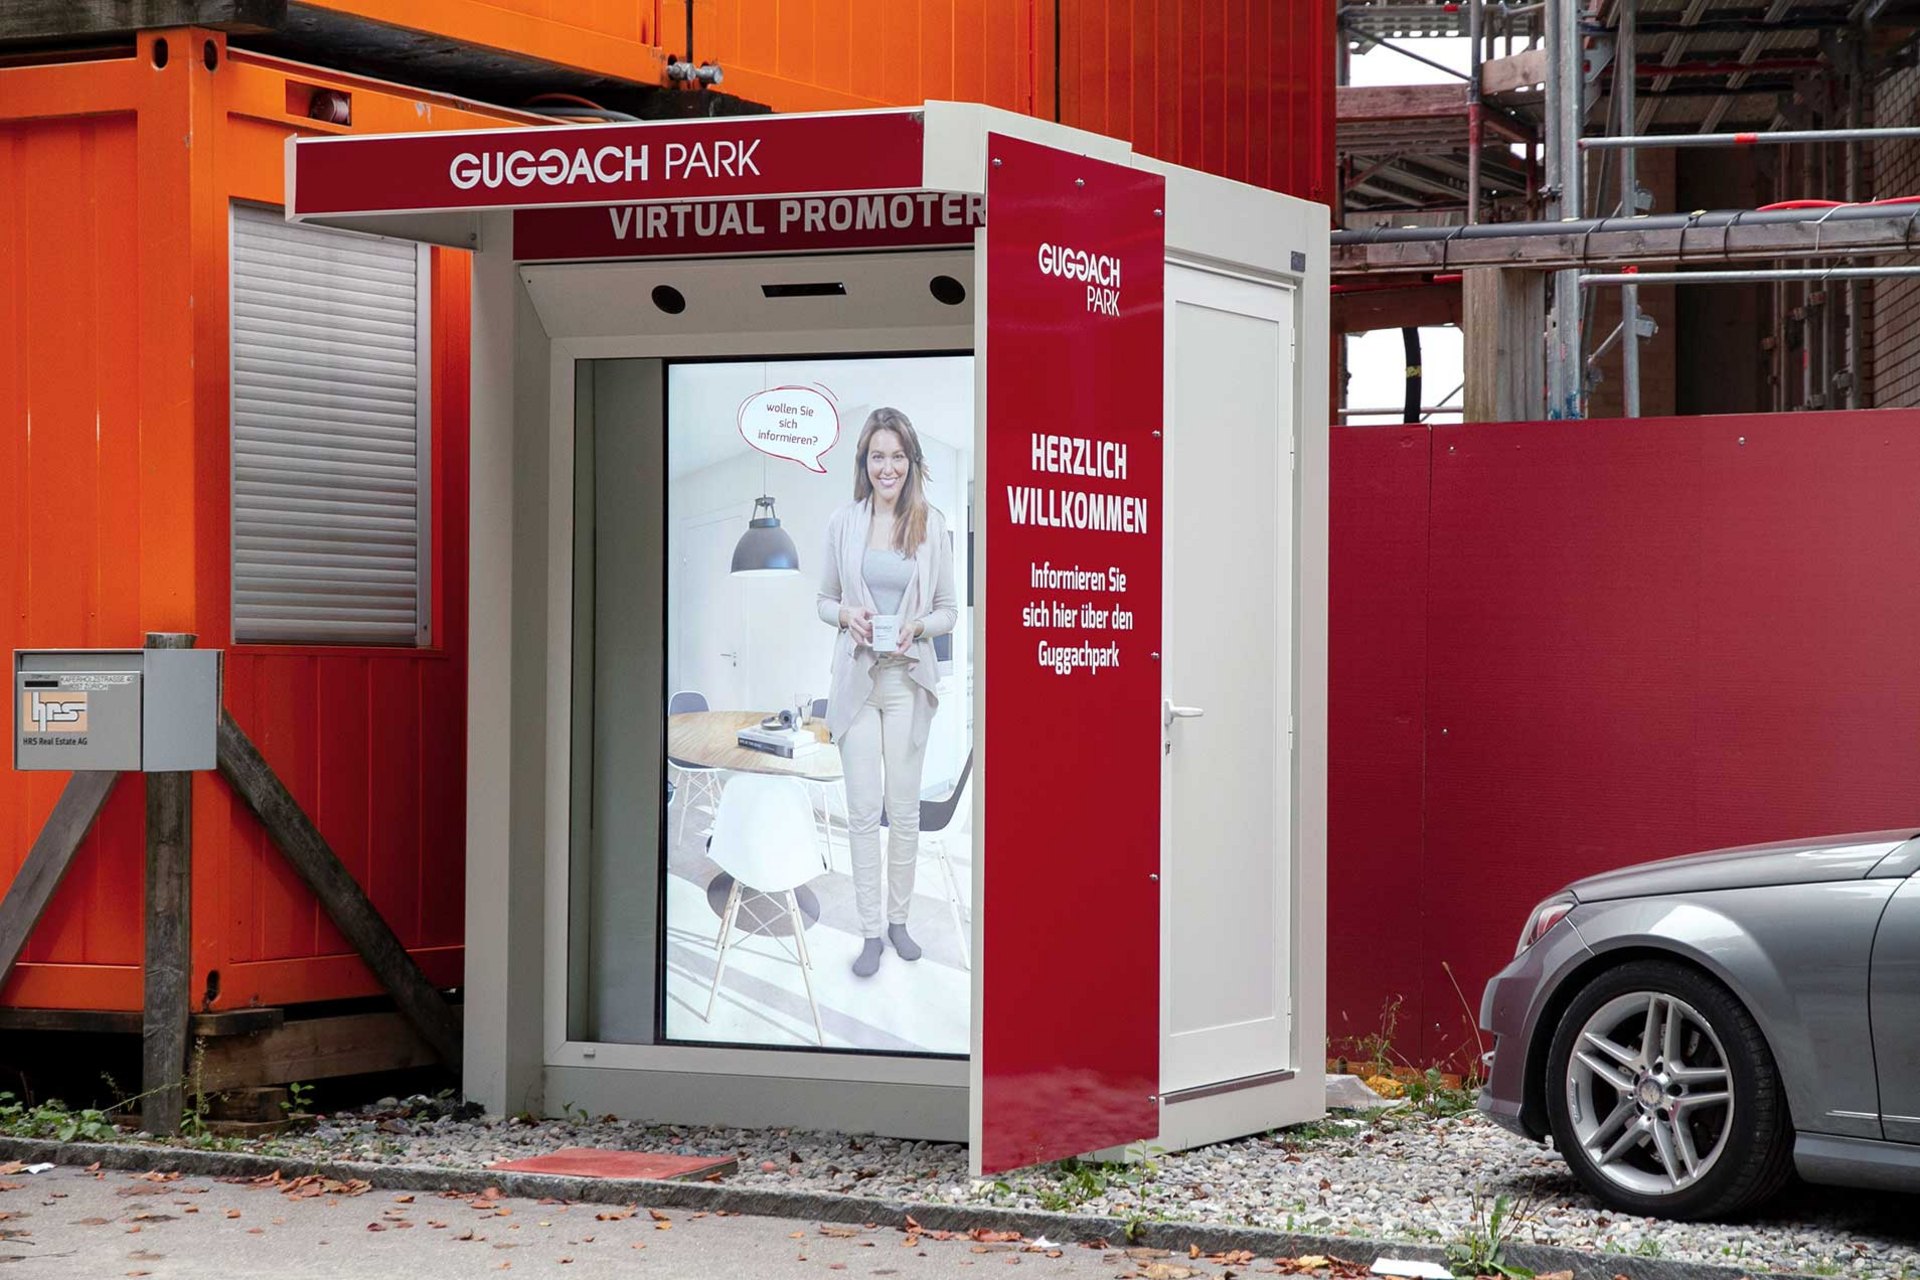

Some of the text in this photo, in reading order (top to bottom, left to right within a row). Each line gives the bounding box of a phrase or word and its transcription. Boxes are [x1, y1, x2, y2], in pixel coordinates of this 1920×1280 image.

[449, 139, 761, 190] GUGGACH PARK
[609, 192, 986, 240] VIRTUAL PROMOTER
[1038, 242, 1121, 289] GUGGACH
[1087, 285, 1120, 317] PARK
[766, 403, 814, 417] wollen Sie
[778, 418, 798, 429] sich
[758, 429, 818, 446] informieren?
[1031, 432, 1127, 481] HERZLICH
[1006, 485, 1148, 534] WILLKOMMEN
[1031, 561, 1127, 592] Informieren Sie
[1022, 599, 1134, 630] sich hier über den
[1038, 639, 1120, 675] Guggachpark
[23, 737, 88, 746] HRS Real Estate AG
